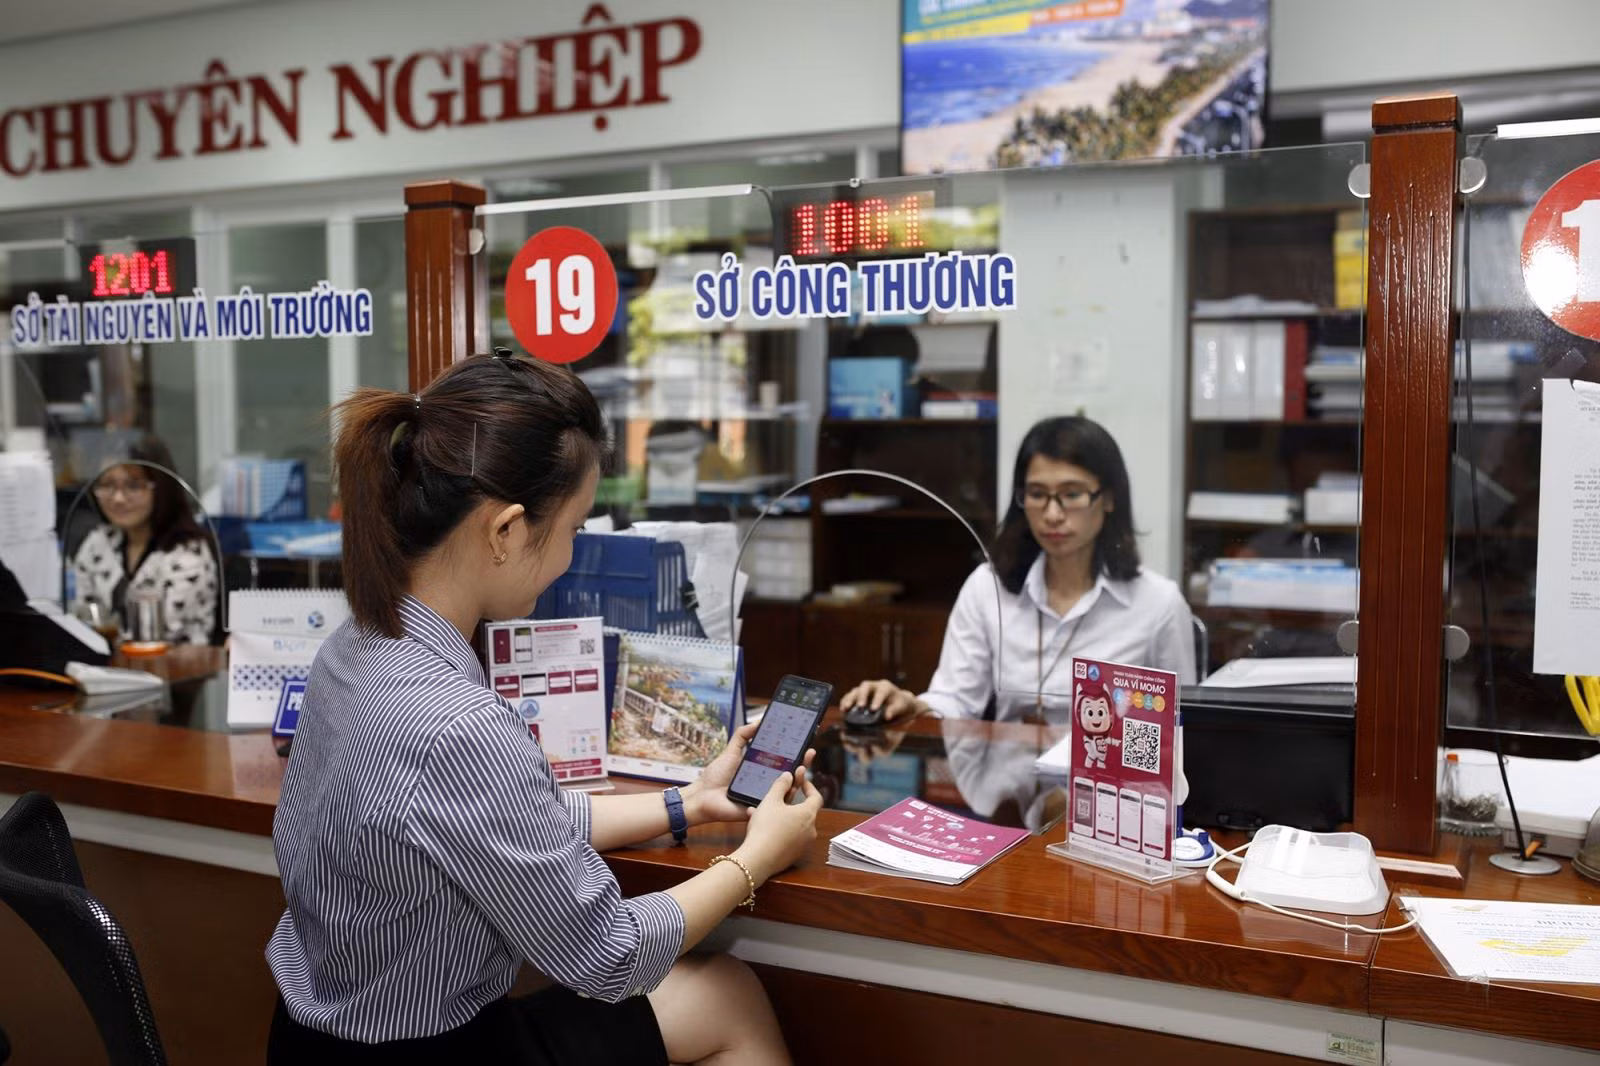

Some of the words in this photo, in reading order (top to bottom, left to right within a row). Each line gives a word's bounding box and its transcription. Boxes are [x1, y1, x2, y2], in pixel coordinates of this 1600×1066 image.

[0, 60, 305, 179] CHUYÊN
[329, 3, 704, 142] NGHIỆP
[794, 195, 926, 256] 1001
[89, 250, 173, 296] 1201
[523, 254, 597, 336] 19
[695, 253, 742, 321] SỞ
[751, 259, 848, 317] CÔNG
[860, 253, 1016, 312] THƯƠNG
[13, 291, 42, 344] SỞ
[46, 294, 80, 342] TÀI
[84, 291, 173, 342] NGUYÊN
[178, 287, 209, 339] VÀ
[216, 286, 262, 337] MÔI
[270, 280, 372, 336] TRƯỜNG
[1113, 677, 1130, 688] QUA
[1131, 679, 1139, 690] VÍ
[1139, 682, 1166, 695] MOMO
